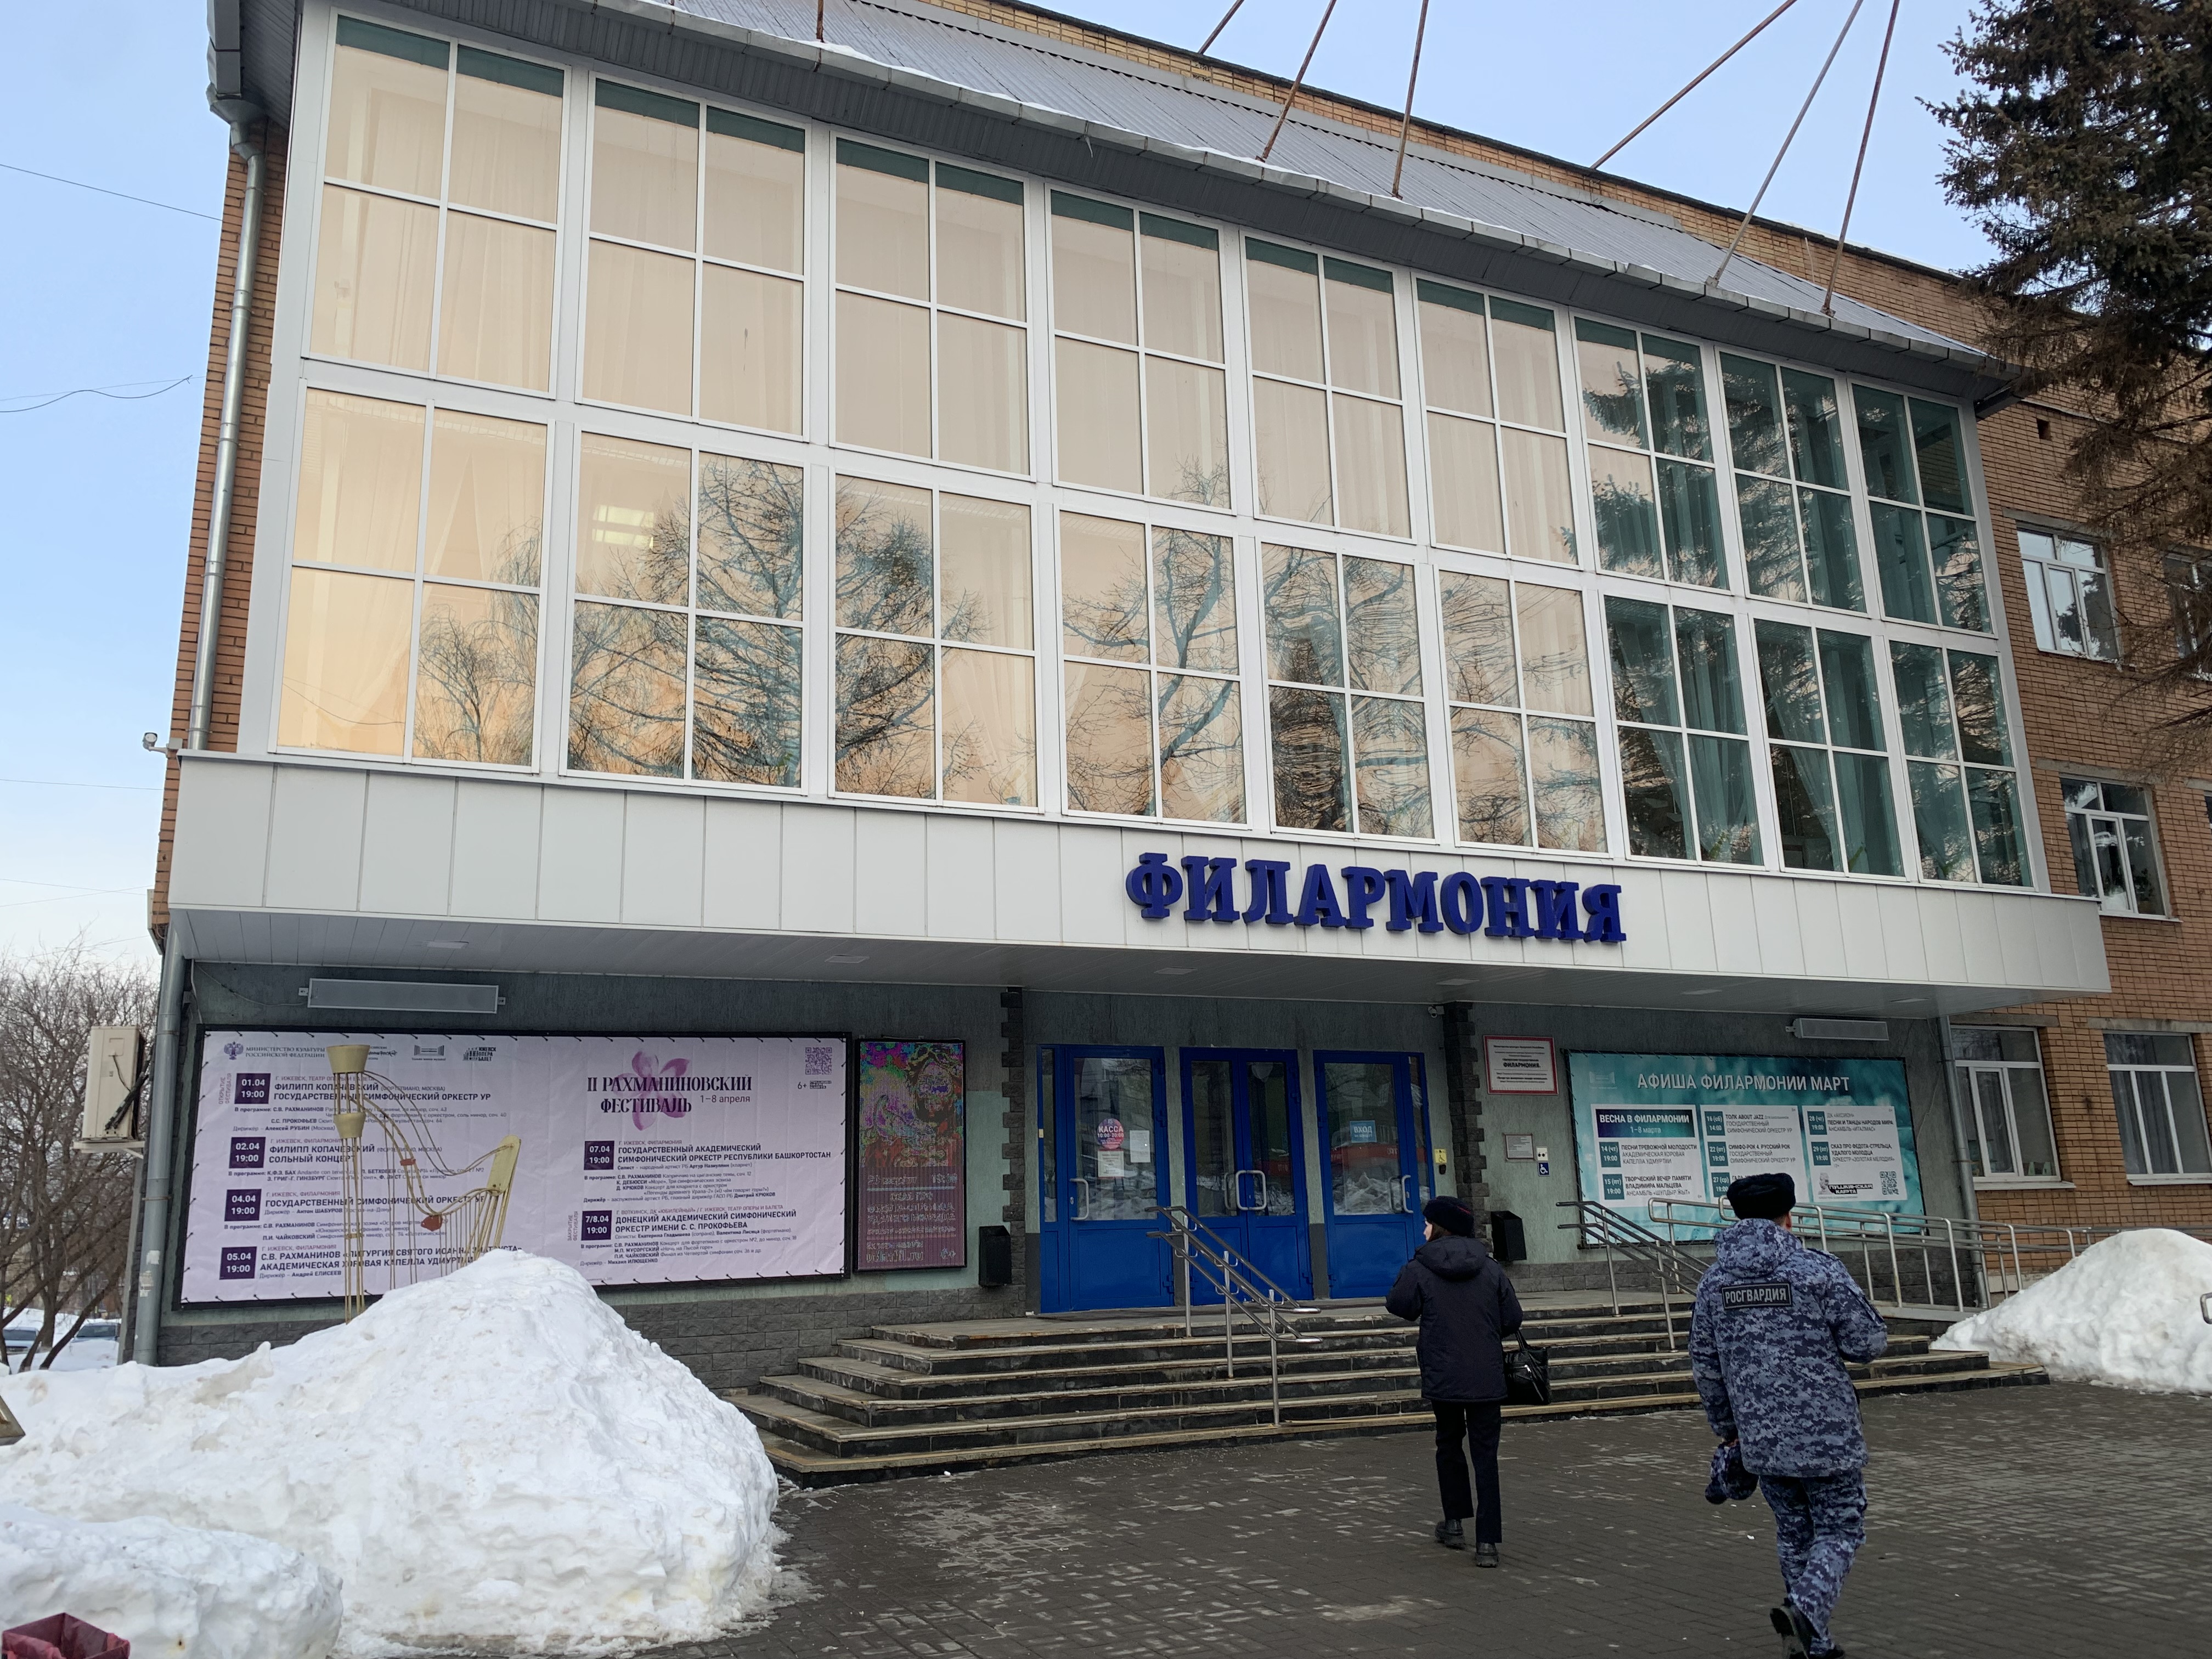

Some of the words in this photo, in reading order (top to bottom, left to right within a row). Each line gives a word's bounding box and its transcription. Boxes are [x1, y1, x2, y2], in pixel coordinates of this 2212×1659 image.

[1126, 853, 1626, 943] ФИЛАРМОНИЯ
[602, 1074, 752, 1091] РАХМАНИНОВСКИЙ
[1638, 1073, 1697, 1090] АФИША
[1701, 1074, 1807, 1091] ФИЛАРМОНИИ
[1810, 1076, 1849, 1091] МАРТ
[601, 1098, 691, 1113] ФЕСТИВАЛЬ
[719, 1096, 750, 1104] апреля
[1600, 1115, 1625, 1123] ВЕСНА
[1634, 1114, 1689, 1123] ФИЛАРМОНИИ
[618, 1144, 693, 1154] ГОСУДАРСТВЕННЫЙ
[696, 1143, 761, 1153] АКАДЕМИЧЕСКИЙ
[269, 1155, 312, 1163] СОЛЬНЫЙ
[618, 1154, 686, 1163] СИМФОНИЧЕСКИЙ
[616, 1215, 658, 1224] ДОНЕЦКИЙ
[661, 1212, 728, 1222] АКАДЕМИЧЕСКИЙ
[730, 1210, 796, 1220] СИМФОНИЧЕСКИЙ
[280, 1251, 340, 1260] РАХМАНИНОВ
[396, 1248, 432, 1256] СВЯТОГО
[260, 1261, 339, 1271] АКАДЕМИЧЕСКАЯ
[1725, 1288, 1787, 1304] РОСГВАРДИЯ
